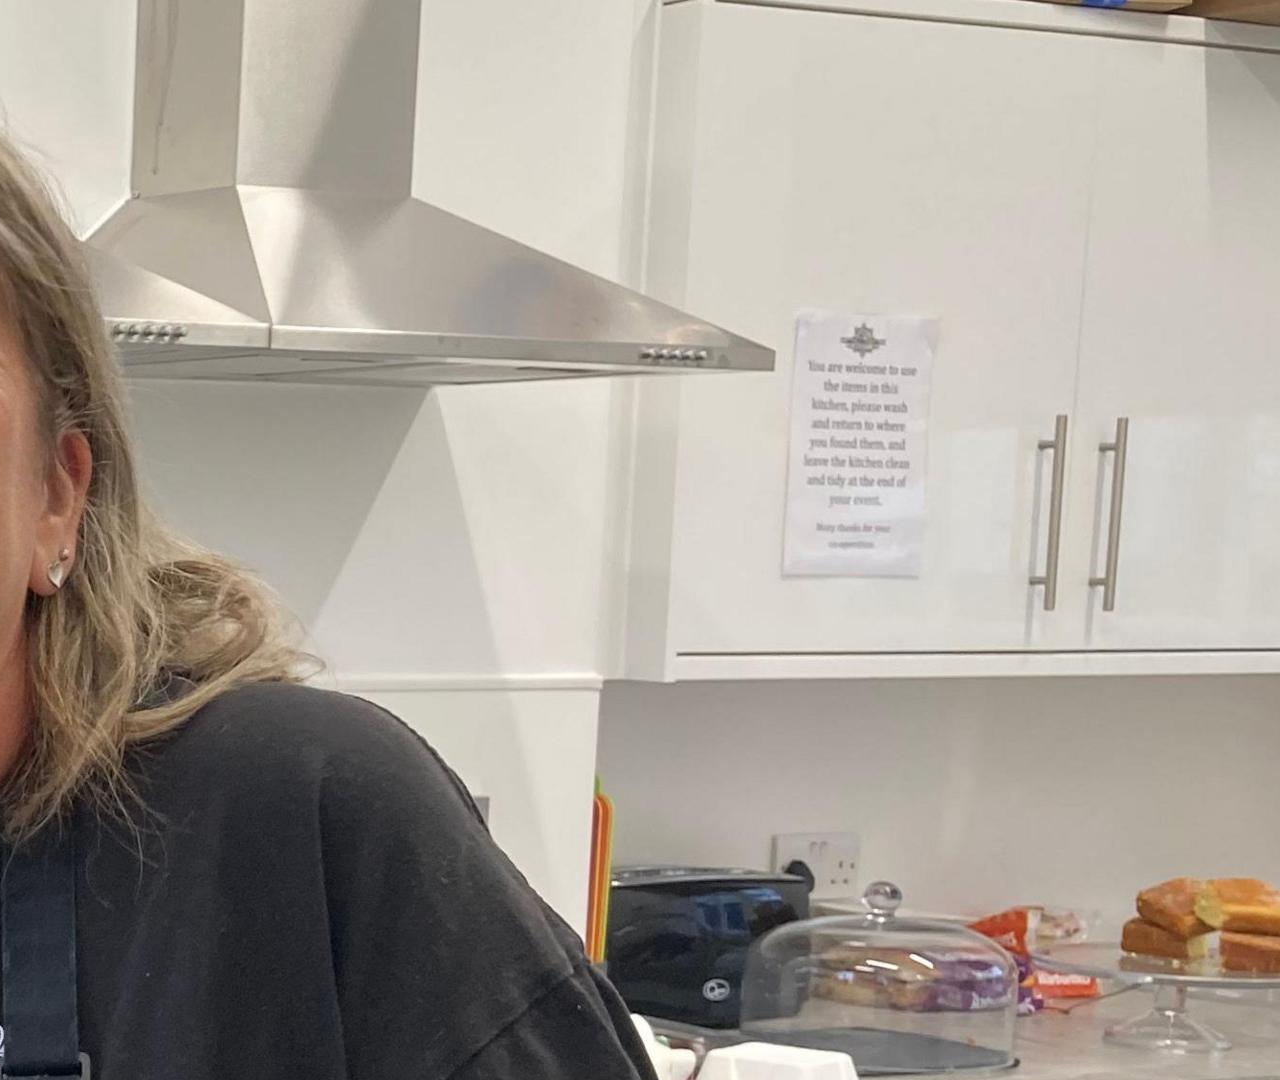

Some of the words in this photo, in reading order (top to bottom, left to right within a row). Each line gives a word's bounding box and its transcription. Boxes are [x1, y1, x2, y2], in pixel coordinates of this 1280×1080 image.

[808, 361, 825, 373] You
[827, 364, 843, 374] are
[845, 362, 887, 375] welcome
[889, 365, 899, 376] to
[900, 367, 917, 377] use
[824, 379, 840, 392] the
[841, 382, 868, 393] items
[870, 383, 879, 394] in
[881, 382, 899, 394] this
[851, 400, 882, 415] please
[884, 401, 908, 413] wash
[811, 418, 830, 430] and
[832, 420, 862, 431] return
[864, 421, 875, 431] to
[877, 420, 906, 432] where
[808, 438, 828, 451] you
[829, 436, 857, 449] found
[888, 438, 906, 450] and
[804, 454, 829, 467] leave
[831, 456, 846, 467] the
[848, 456, 883, 469] kitchen
[885, 457, 910, 470] clean
[806, 474, 825, 486] and
[827, 473, 846, 488] tidy
[847, 476, 858, 487] at
[859, 475, 875, 487] the
[877, 476, 895, 488] end
[897, 475, 907, 488] of
[828, 496, 851, 509] your
